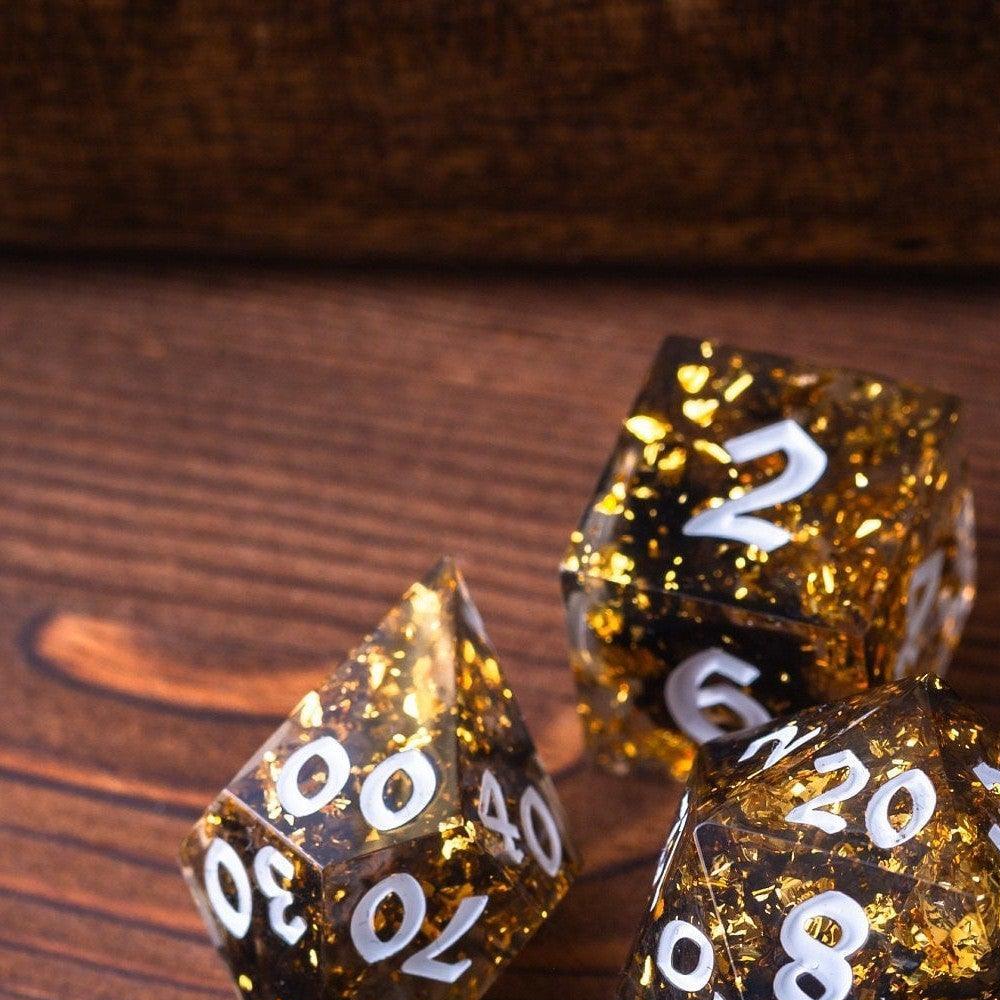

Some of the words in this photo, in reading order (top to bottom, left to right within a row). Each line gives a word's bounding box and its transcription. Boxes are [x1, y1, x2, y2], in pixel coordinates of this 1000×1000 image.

[683, 420, 828, 552] 2
[664, 647, 772, 745] 6
[276, 736, 437, 832] 00
[478, 769, 562, 877] 40
[784, 749, 938, 850] 20
[204, 838, 308, 944] 30
[350, 873, 488, 984] 70
